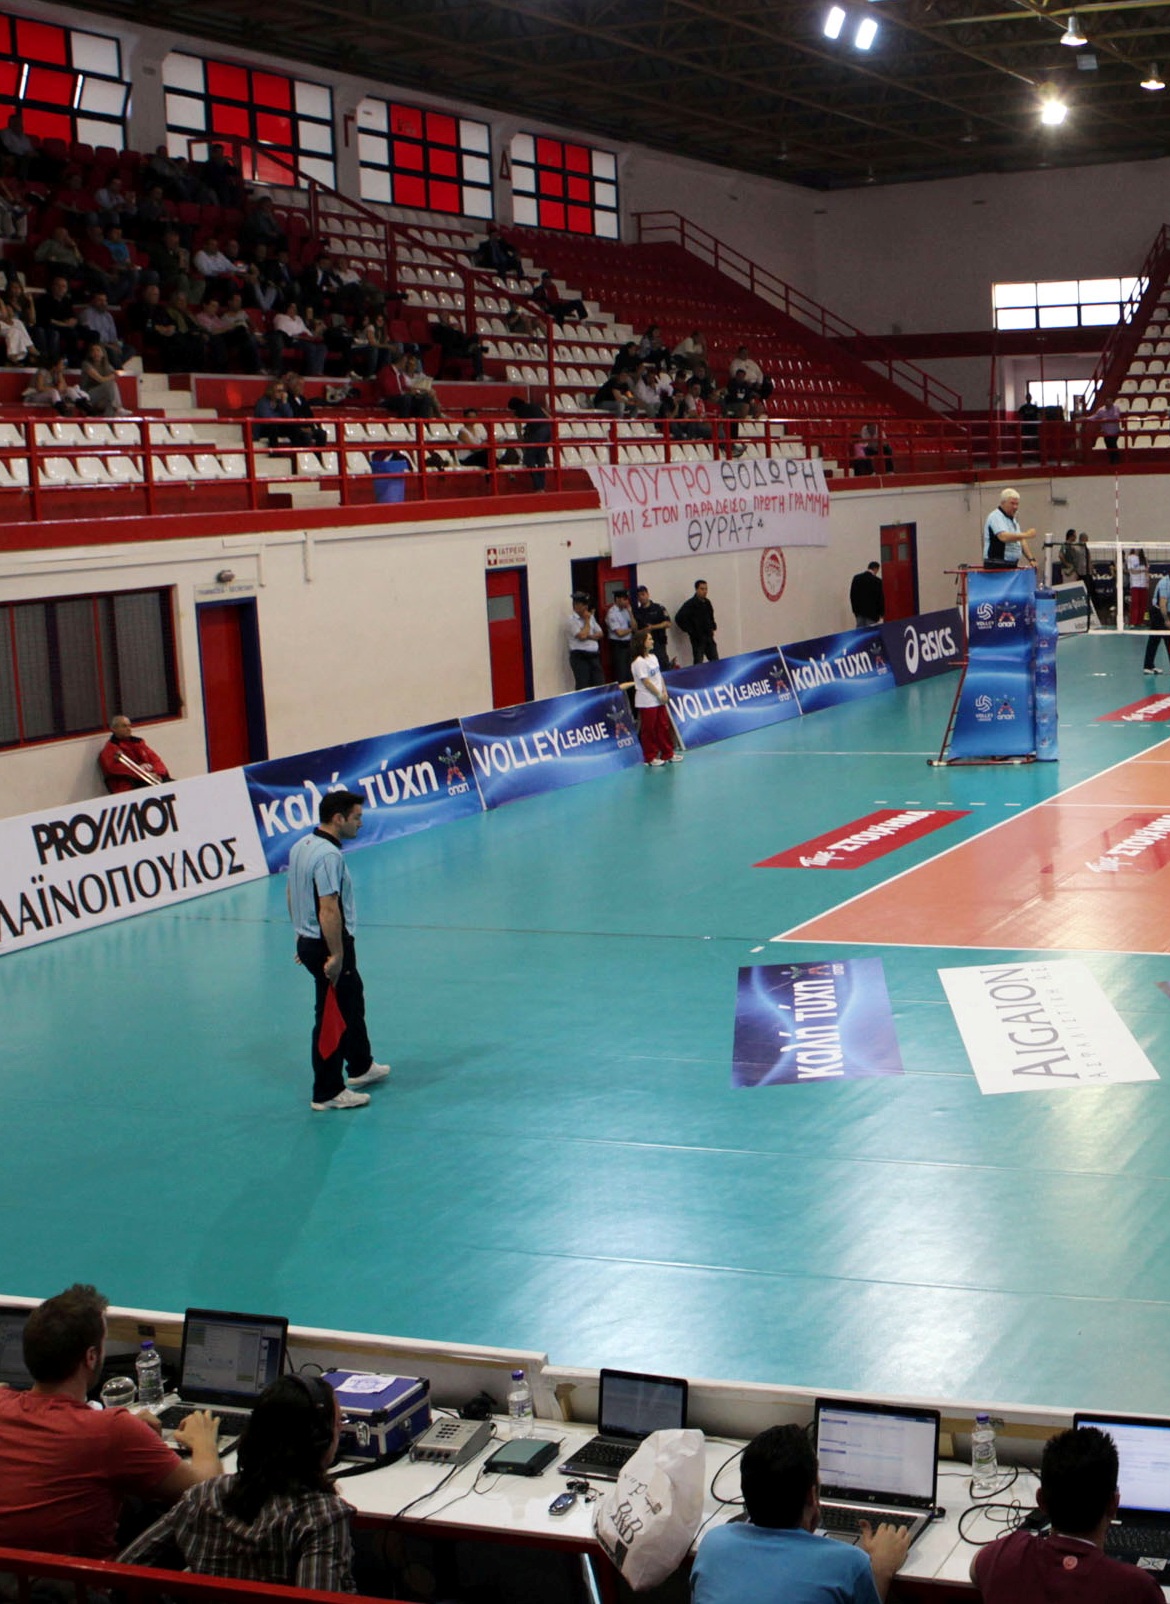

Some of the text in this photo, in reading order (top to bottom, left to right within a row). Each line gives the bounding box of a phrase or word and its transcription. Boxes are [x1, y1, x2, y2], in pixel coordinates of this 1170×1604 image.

[597, 460, 818, 506] ΜΟΥΤΡΟ ΘΟΔΩΡΗ
[612, 492, 830, 535] ΚΑΙ ΣΤΟΝ ΠΑΡΑΔΕΙΣΟ ΠΡΩΤΗ ΓΡΑΜΜΗ
[790, 648, 873, 693] καλή τύχη
[669, 679, 773, 723] VOLLEY LEAGUE
[472, 721, 611, 777] VOLLEY LEAGUE
[258, 759, 440, 837] καλ τύχη
[778, 979, 845, 1080] καλή τύχη
[980, 967, 1081, 1079] AIGAION
